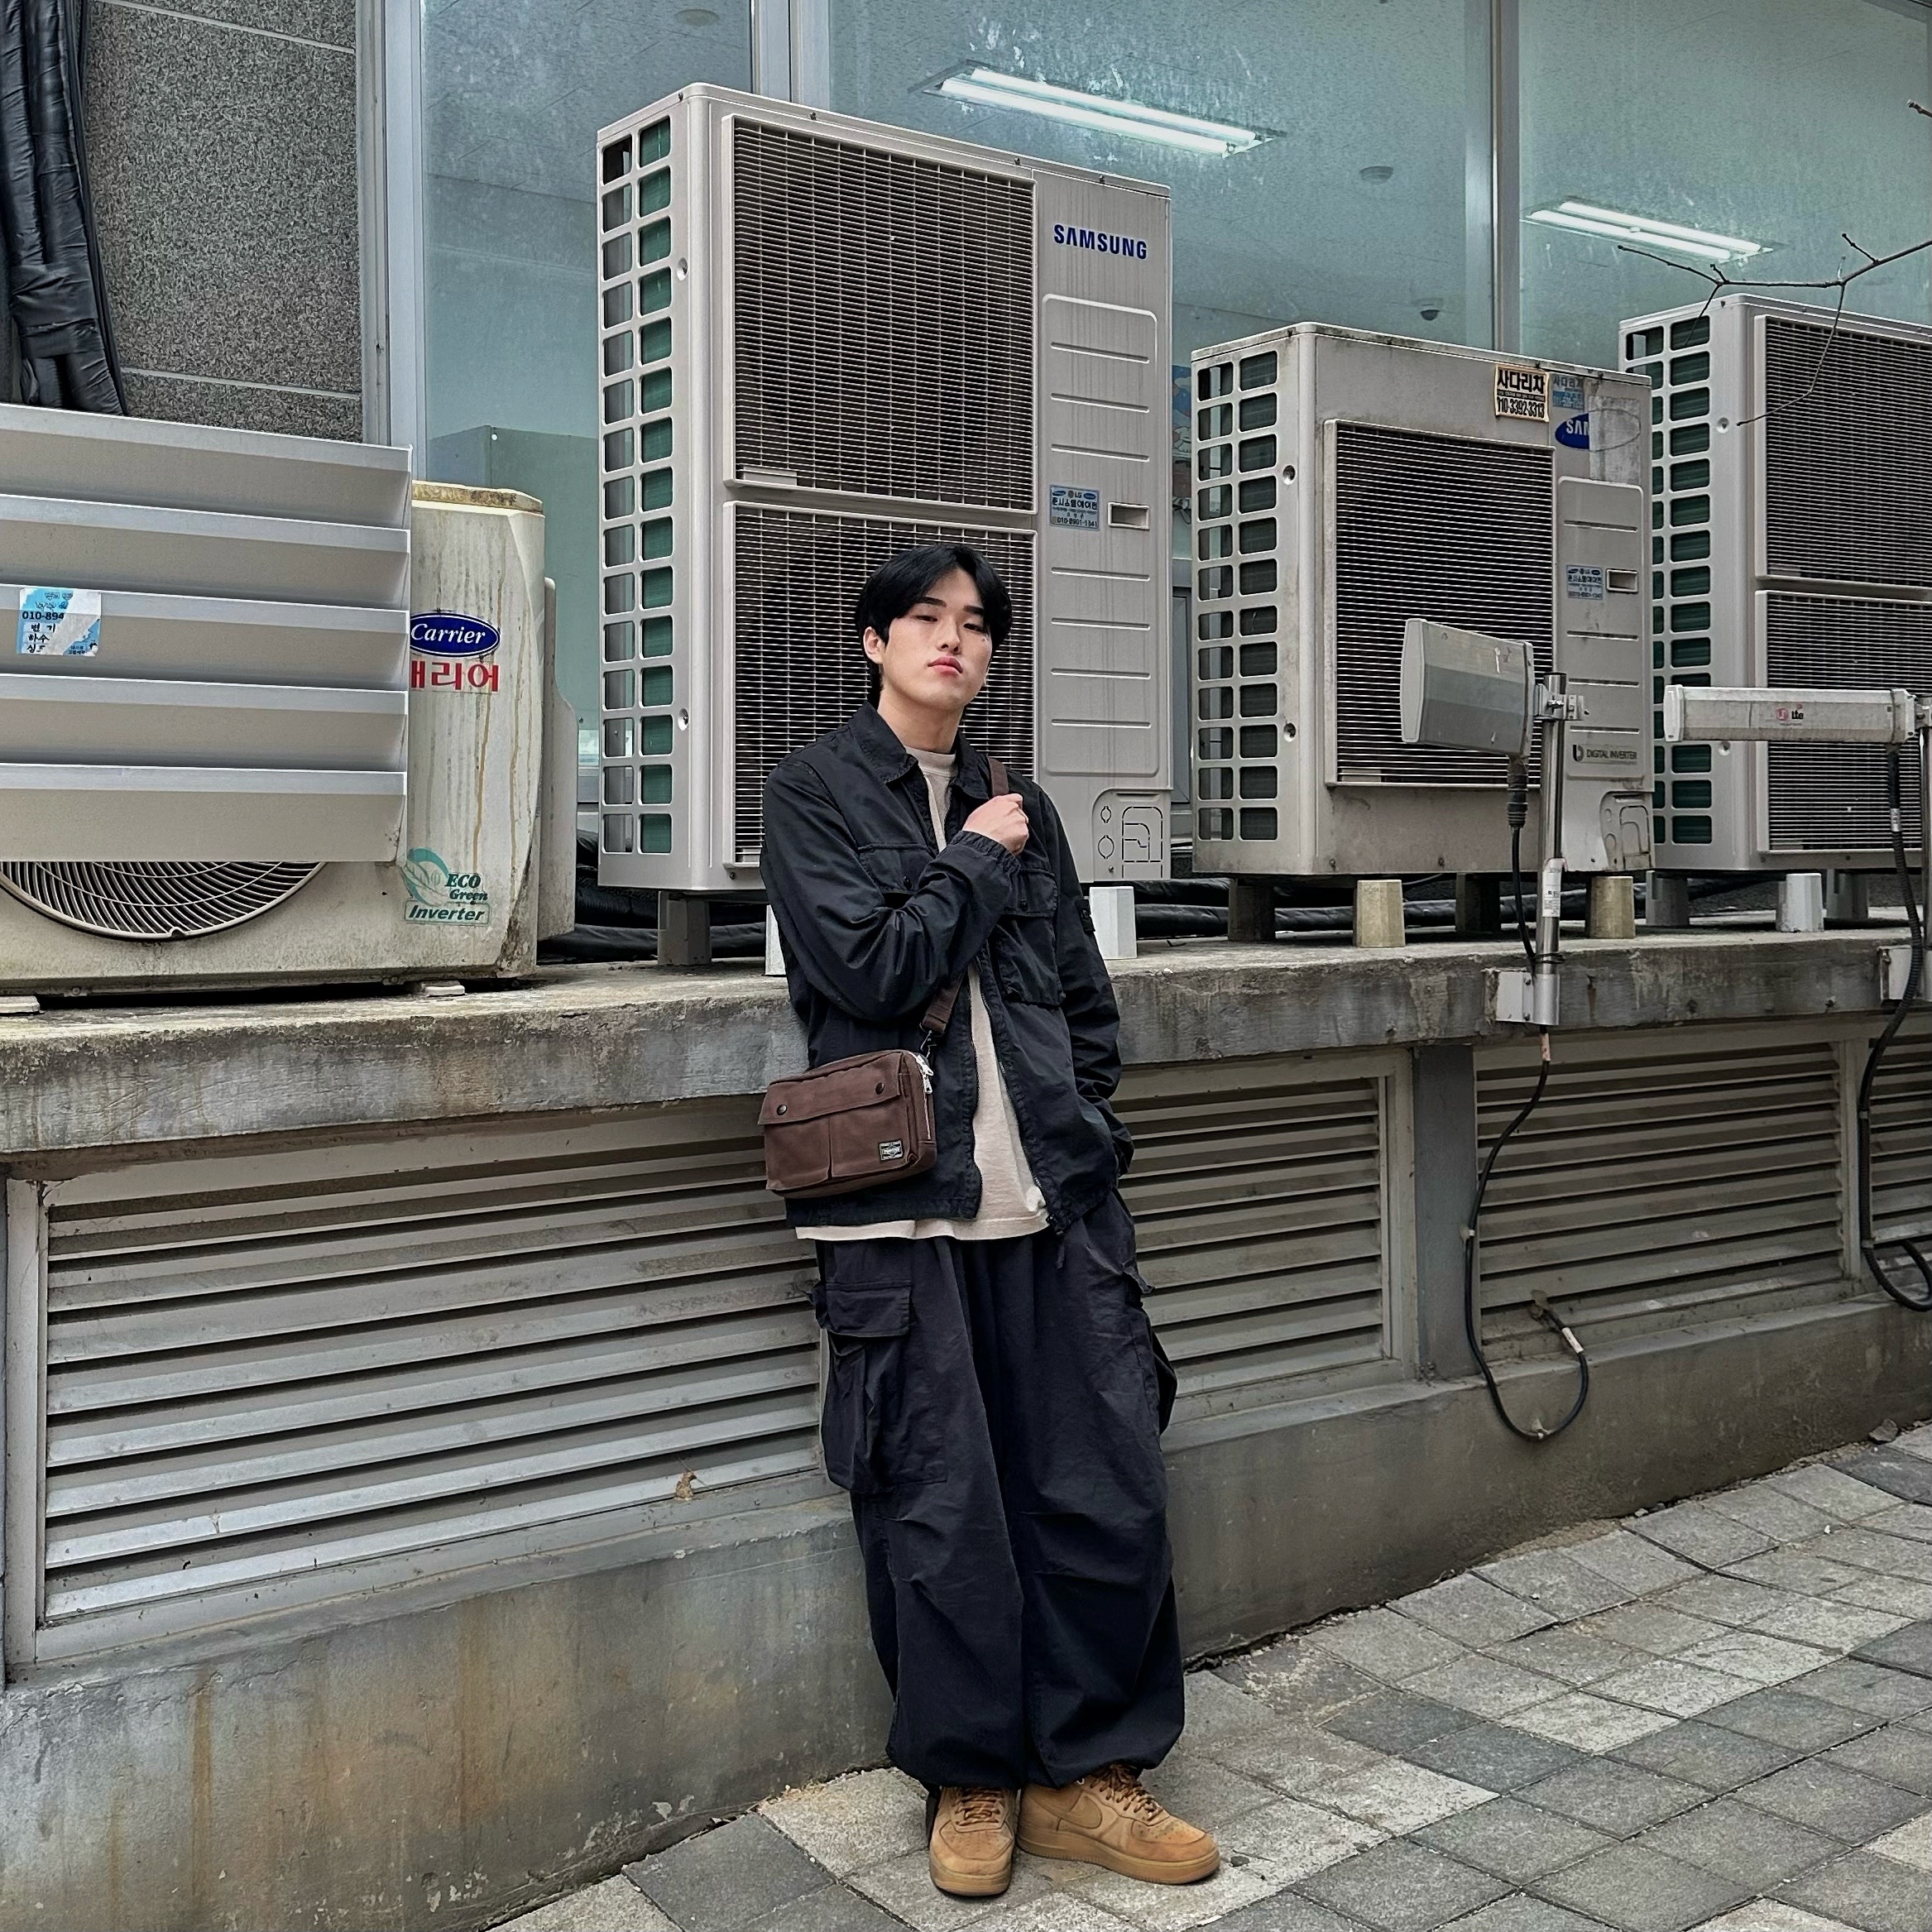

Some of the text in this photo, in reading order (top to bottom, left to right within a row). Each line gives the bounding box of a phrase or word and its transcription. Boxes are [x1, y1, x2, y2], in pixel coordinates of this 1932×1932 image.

[1053, 224, 1147, 259] SAMSUNG
[1497, 369, 1546, 395] 사다리차
[410, 623, 487, 645] Carrier
[444, 873, 482, 889] ECO
[448, 889, 488, 901] Green
[408, 904, 485, 922] Inverter
